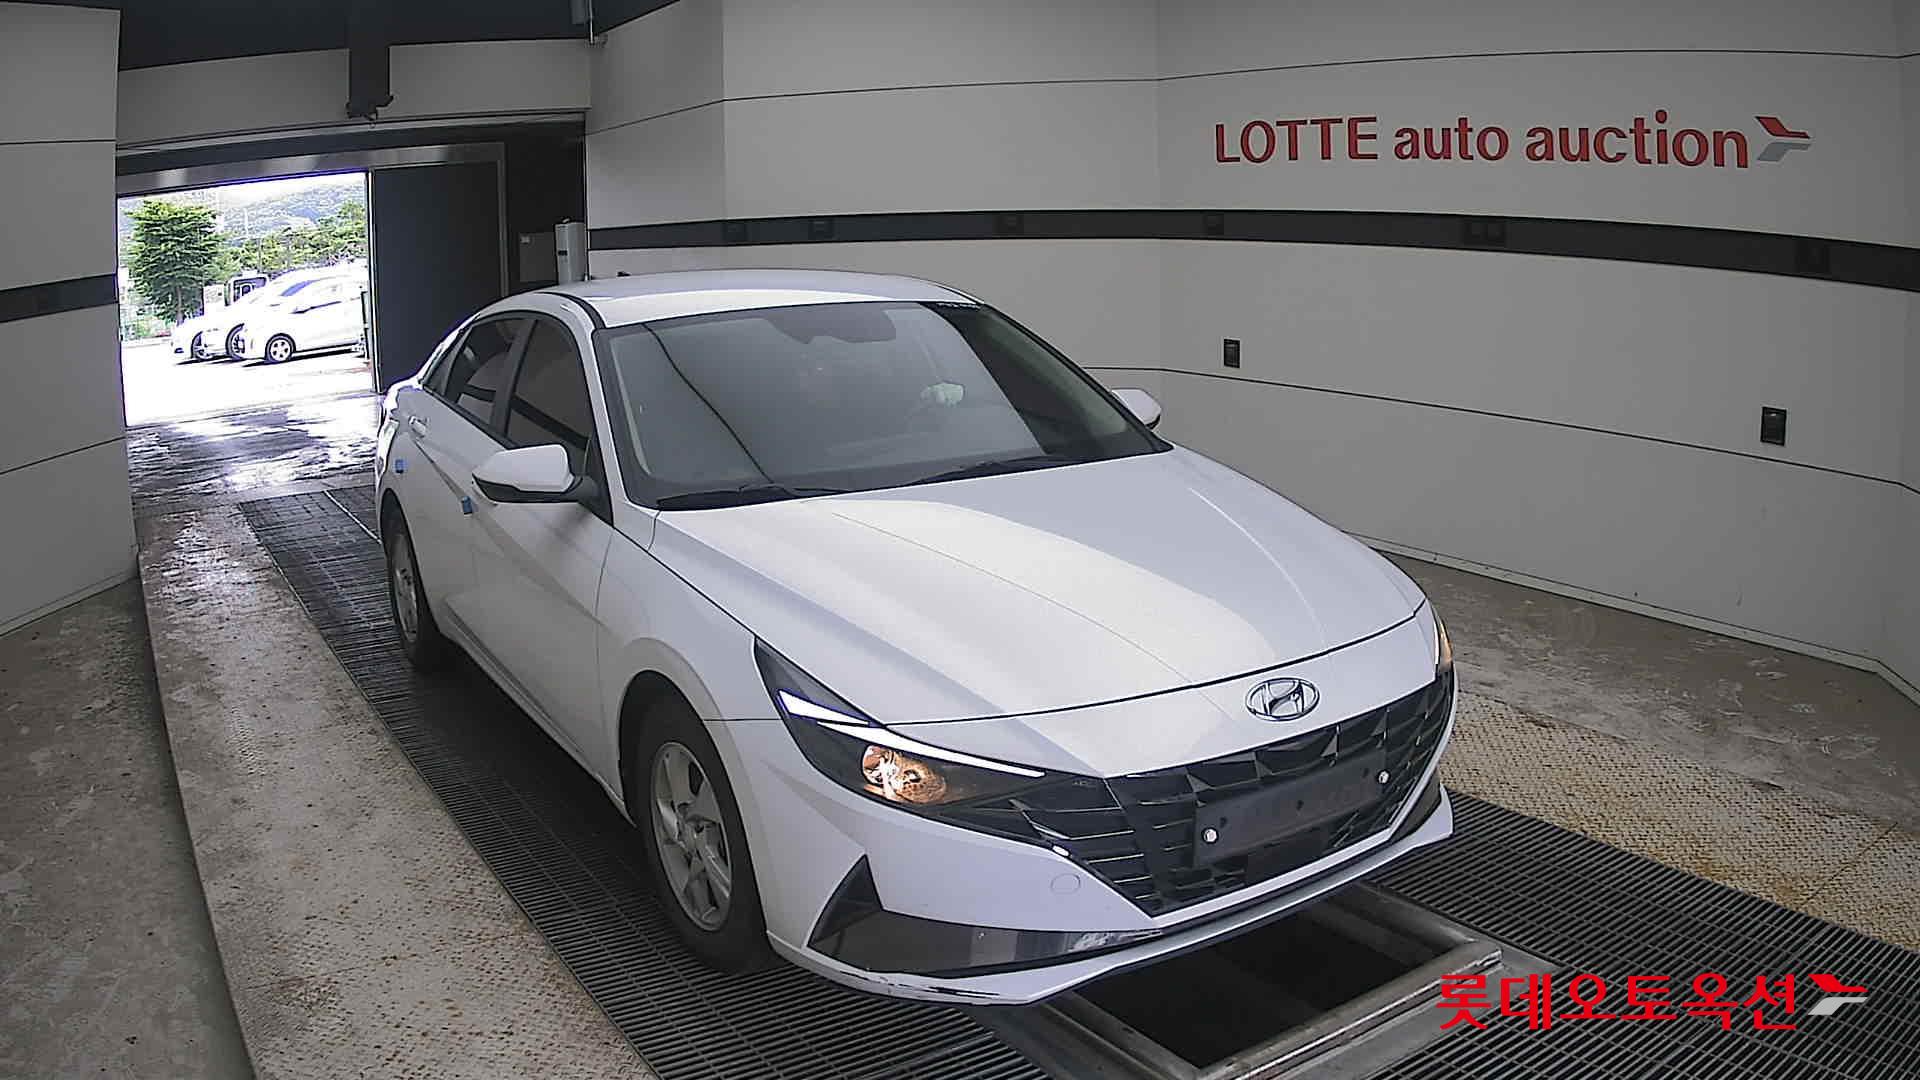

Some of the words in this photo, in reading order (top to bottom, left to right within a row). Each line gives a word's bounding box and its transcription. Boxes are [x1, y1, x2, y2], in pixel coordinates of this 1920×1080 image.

[1215, 116, 1378, 163] LOTTE
[1393, 117, 1509, 162] auto
[1525, 110, 1750, 168] auction
